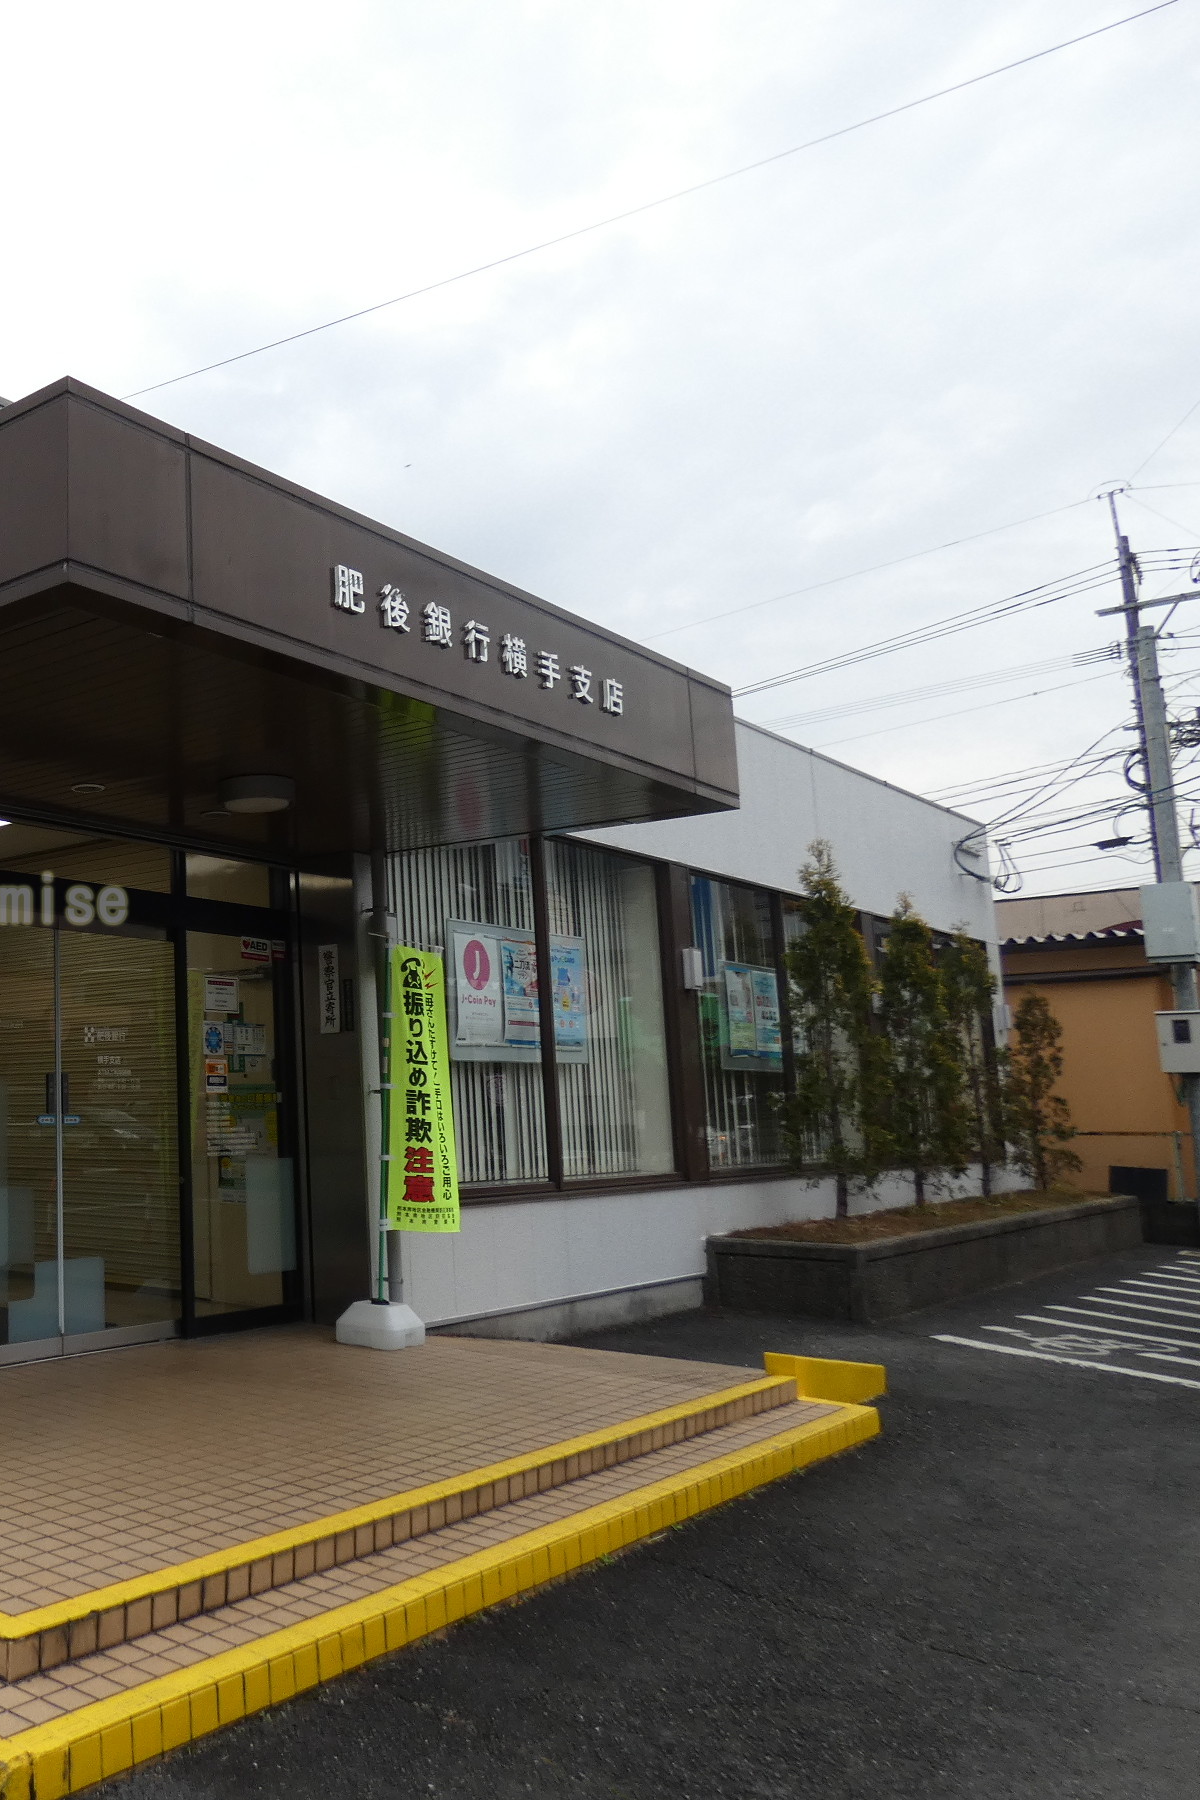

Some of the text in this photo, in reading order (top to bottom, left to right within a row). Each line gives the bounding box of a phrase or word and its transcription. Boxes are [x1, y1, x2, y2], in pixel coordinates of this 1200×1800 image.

[334, 564, 624, 716] 肥後銀行横手支店
[250, 940, 268, 951] AED
[322, 950, 337, 1028] 警察官立寄所
[484, 995, 497, 1007] Pay
[402, 990, 436, 1203] 振り込め詐欺注意
